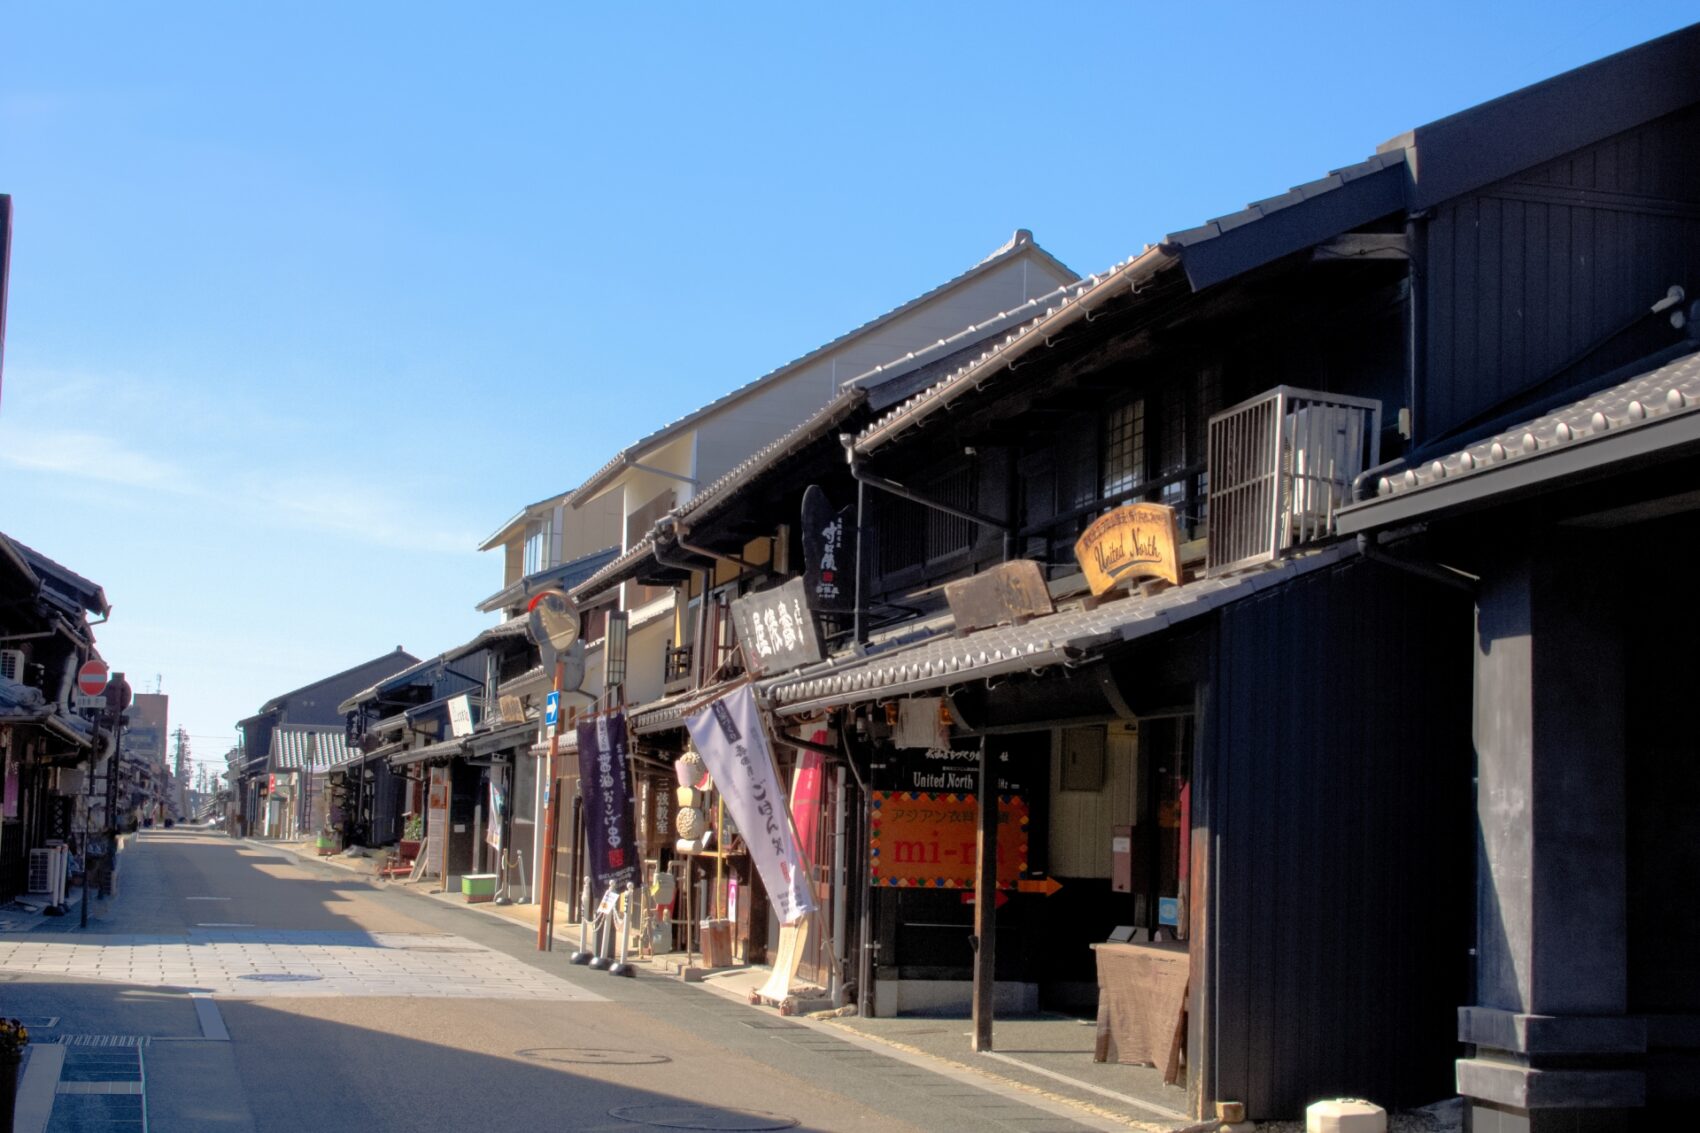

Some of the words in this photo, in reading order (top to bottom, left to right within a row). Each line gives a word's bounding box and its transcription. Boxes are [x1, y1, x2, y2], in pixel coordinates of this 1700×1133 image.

[1094, 533, 1126, 573] United
[1130, 527, 1160, 560] North
[913, 771, 945, 788] United
[947, 772, 973, 789] North
